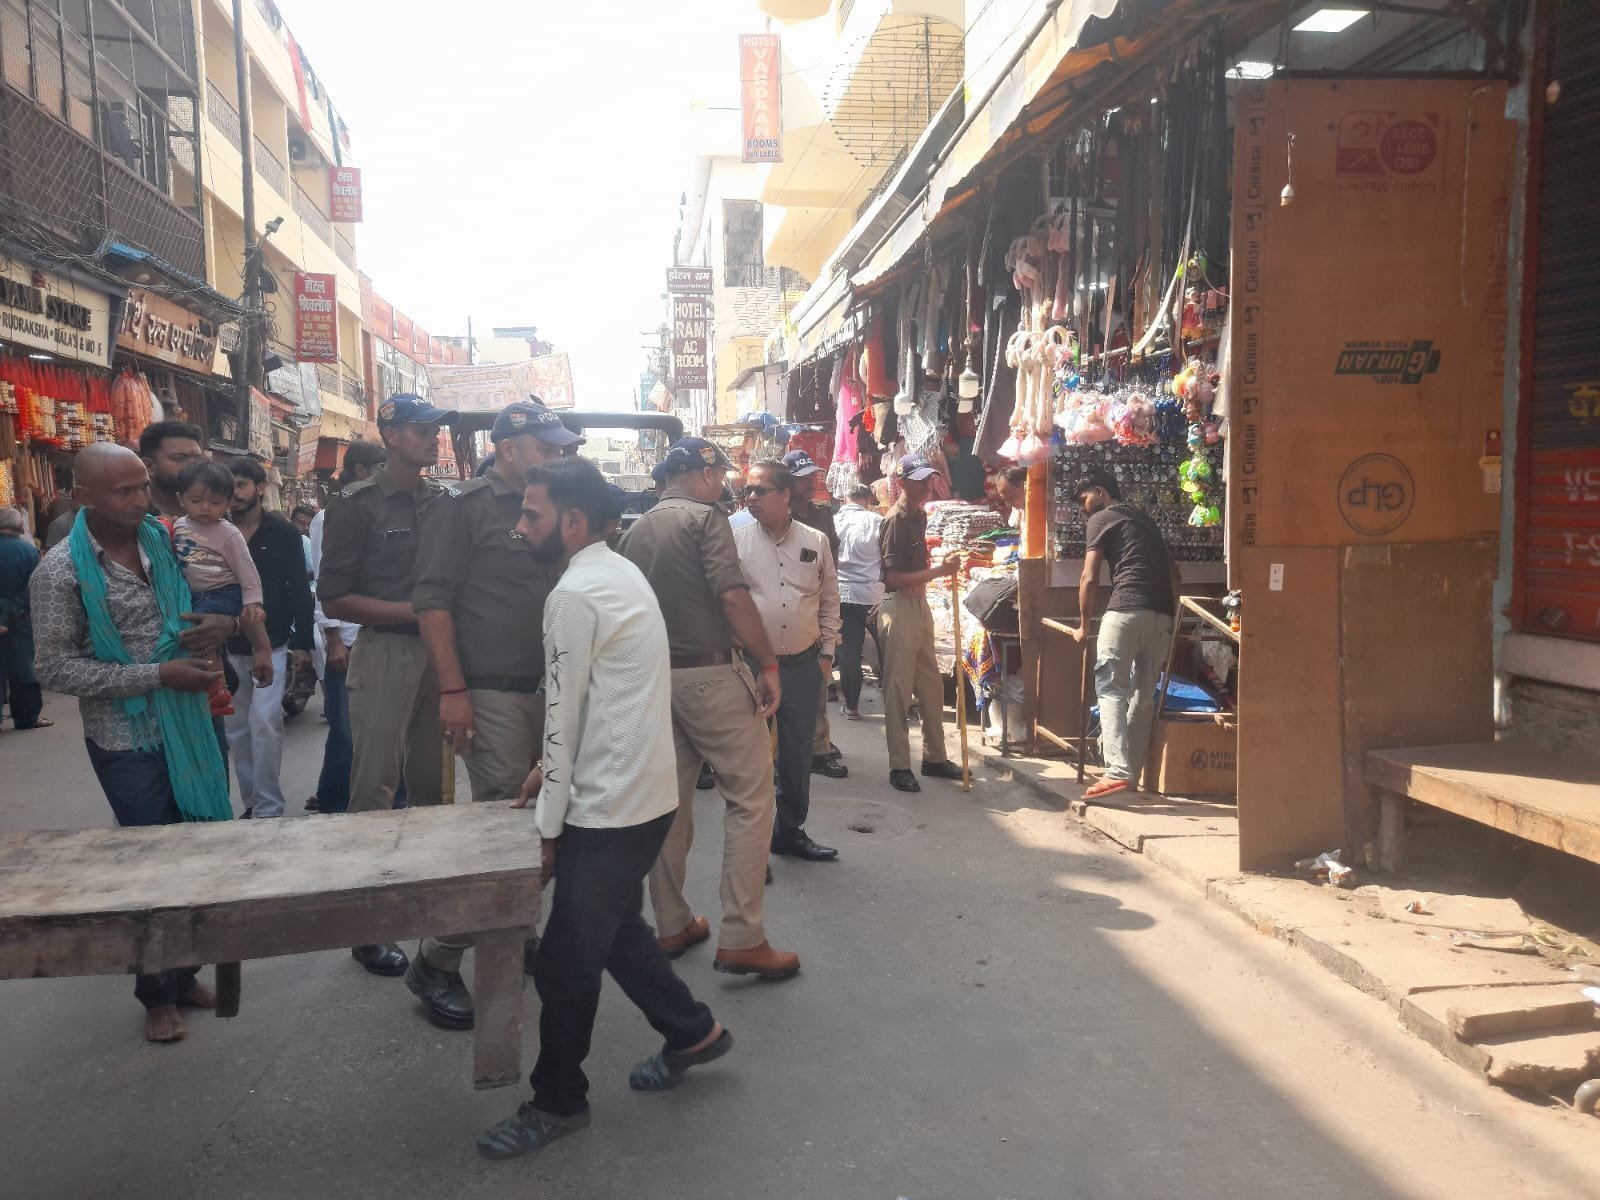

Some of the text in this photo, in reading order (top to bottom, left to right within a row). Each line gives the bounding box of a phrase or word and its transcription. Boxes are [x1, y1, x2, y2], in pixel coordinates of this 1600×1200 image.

[744, 37, 777, 47] HOTEL
[747, 139, 778, 149] ROOMS
[1248, 145, 1263, 199] CHERISH
[1393, 156, 1421, 168] ISO
[1245, 241, 1259, 293] CHERISH
[675, 302, 706, 319] HOTEL
[2, 312, 49, 340] RUDRAKSHA
[676, 320, 706, 339] RAM
[683, 341, 698, 354] AC
[676, 355, 705, 368] ROOM
[1243, 333, 1258, 385] CHERISH
[1340, 352, 1427, 374] GURJAN
[1243, 424, 1257, 474] CHERISH
[1348, 479, 1405, 511] GLP
